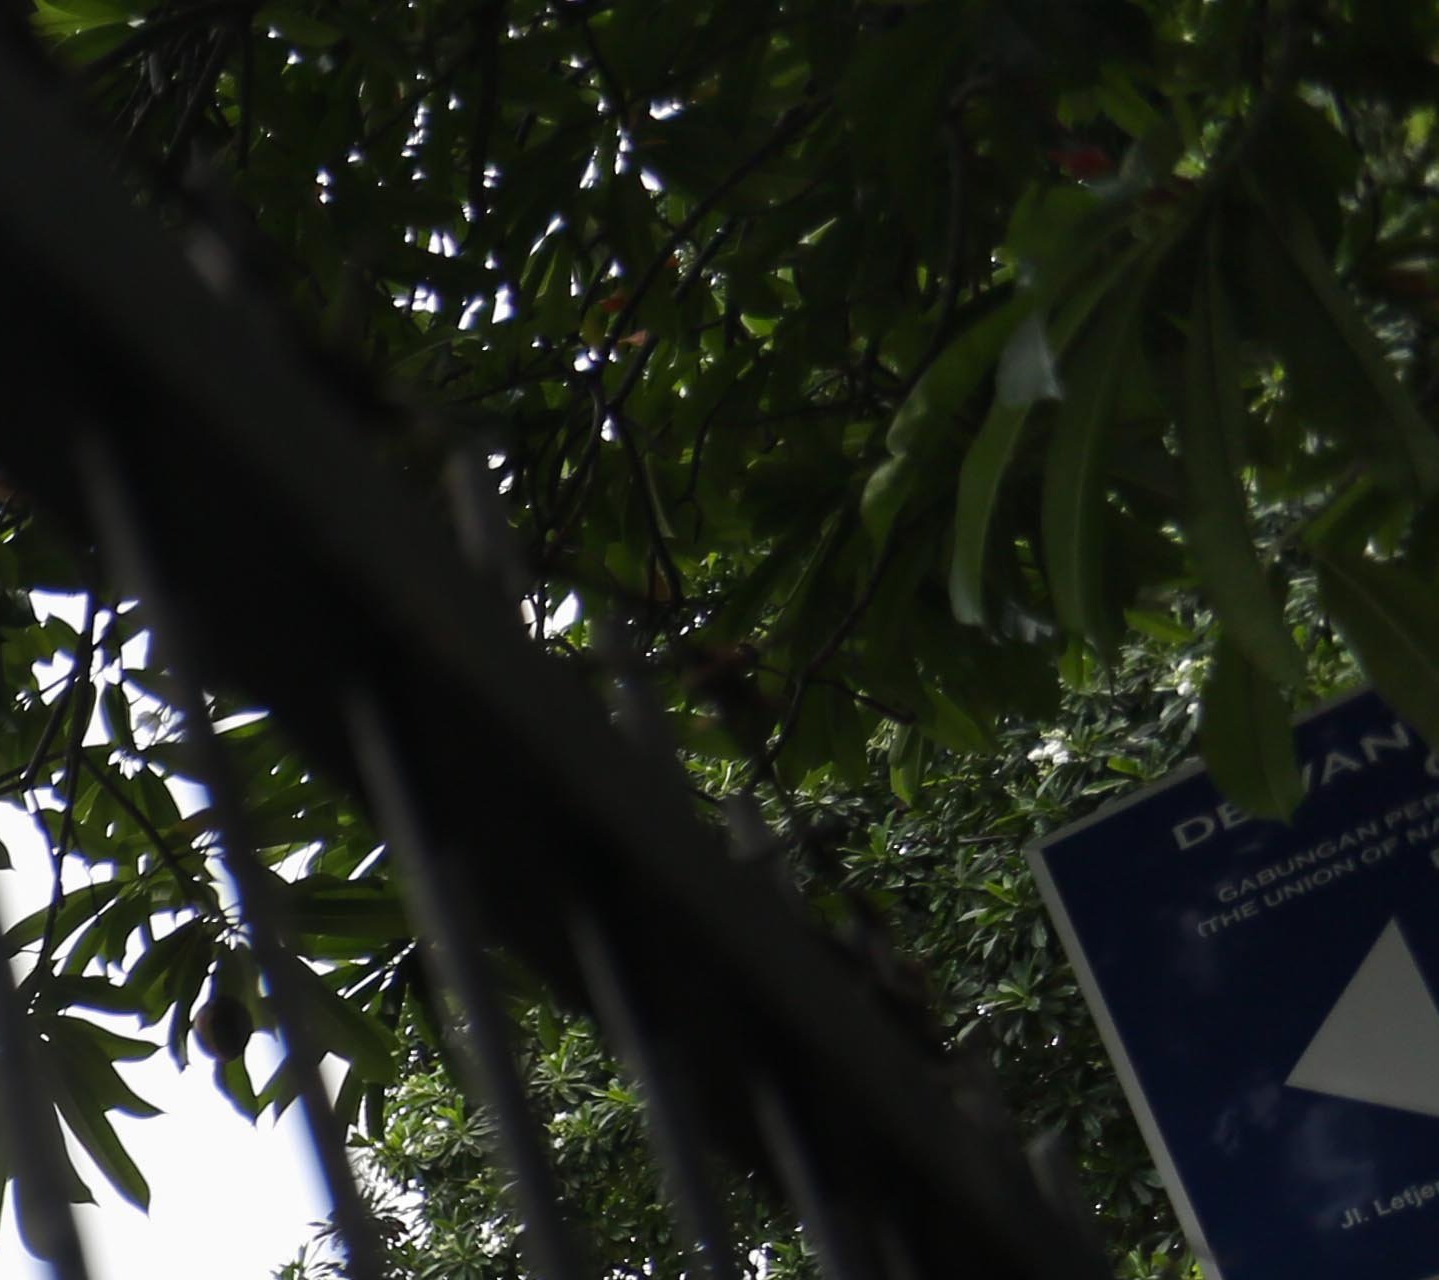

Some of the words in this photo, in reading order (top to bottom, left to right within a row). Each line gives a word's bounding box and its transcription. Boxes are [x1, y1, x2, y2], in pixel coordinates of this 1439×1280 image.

[1172, 721, 1411, 850] DEAN
[1218, 820, 1379, 902] GABUNGAN
[1263, 857, 1356, 908] UNION
[1360, 837, 1399, 864] OF
